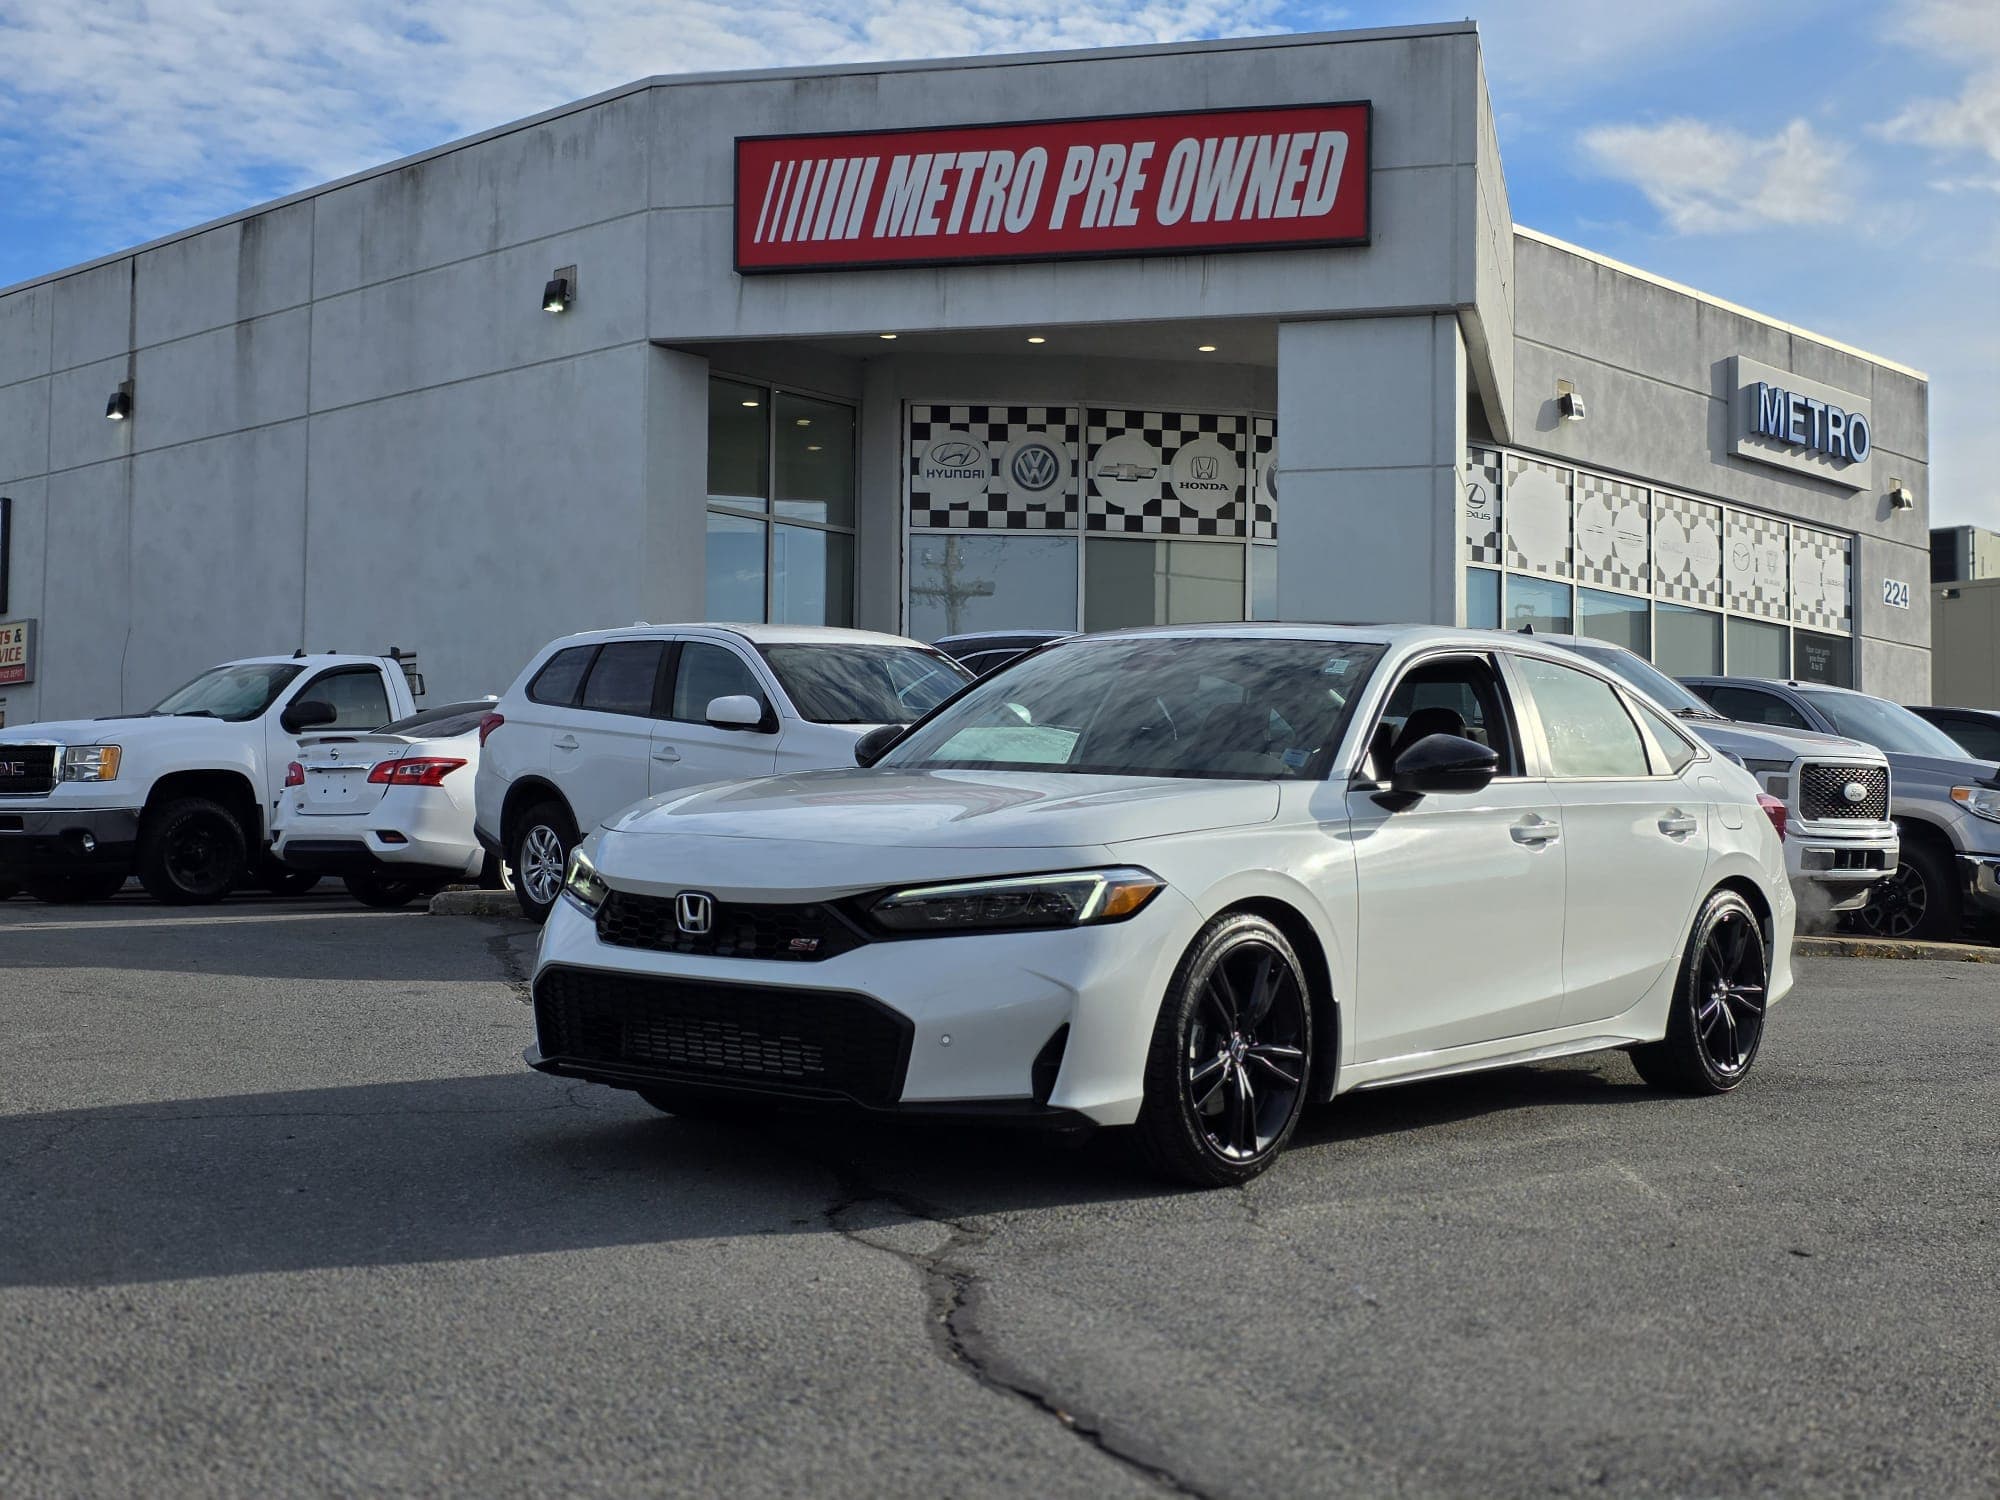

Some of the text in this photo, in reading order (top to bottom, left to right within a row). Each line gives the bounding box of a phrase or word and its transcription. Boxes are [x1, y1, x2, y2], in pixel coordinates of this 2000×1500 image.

[873, 131, 1349, 238] METRO PRE OWNED
[1759, 382, 1871, 464] METRO
[926, 468, 985, 479] HYUNDAI
[1179, 481, 1229, 491] HONDA
[1466, 510, 1491, 521] EXUS
[1884, 580, 1908, 607] 224
[14, 628, 22, 643] &
[0, 761, 25, 776] MC
